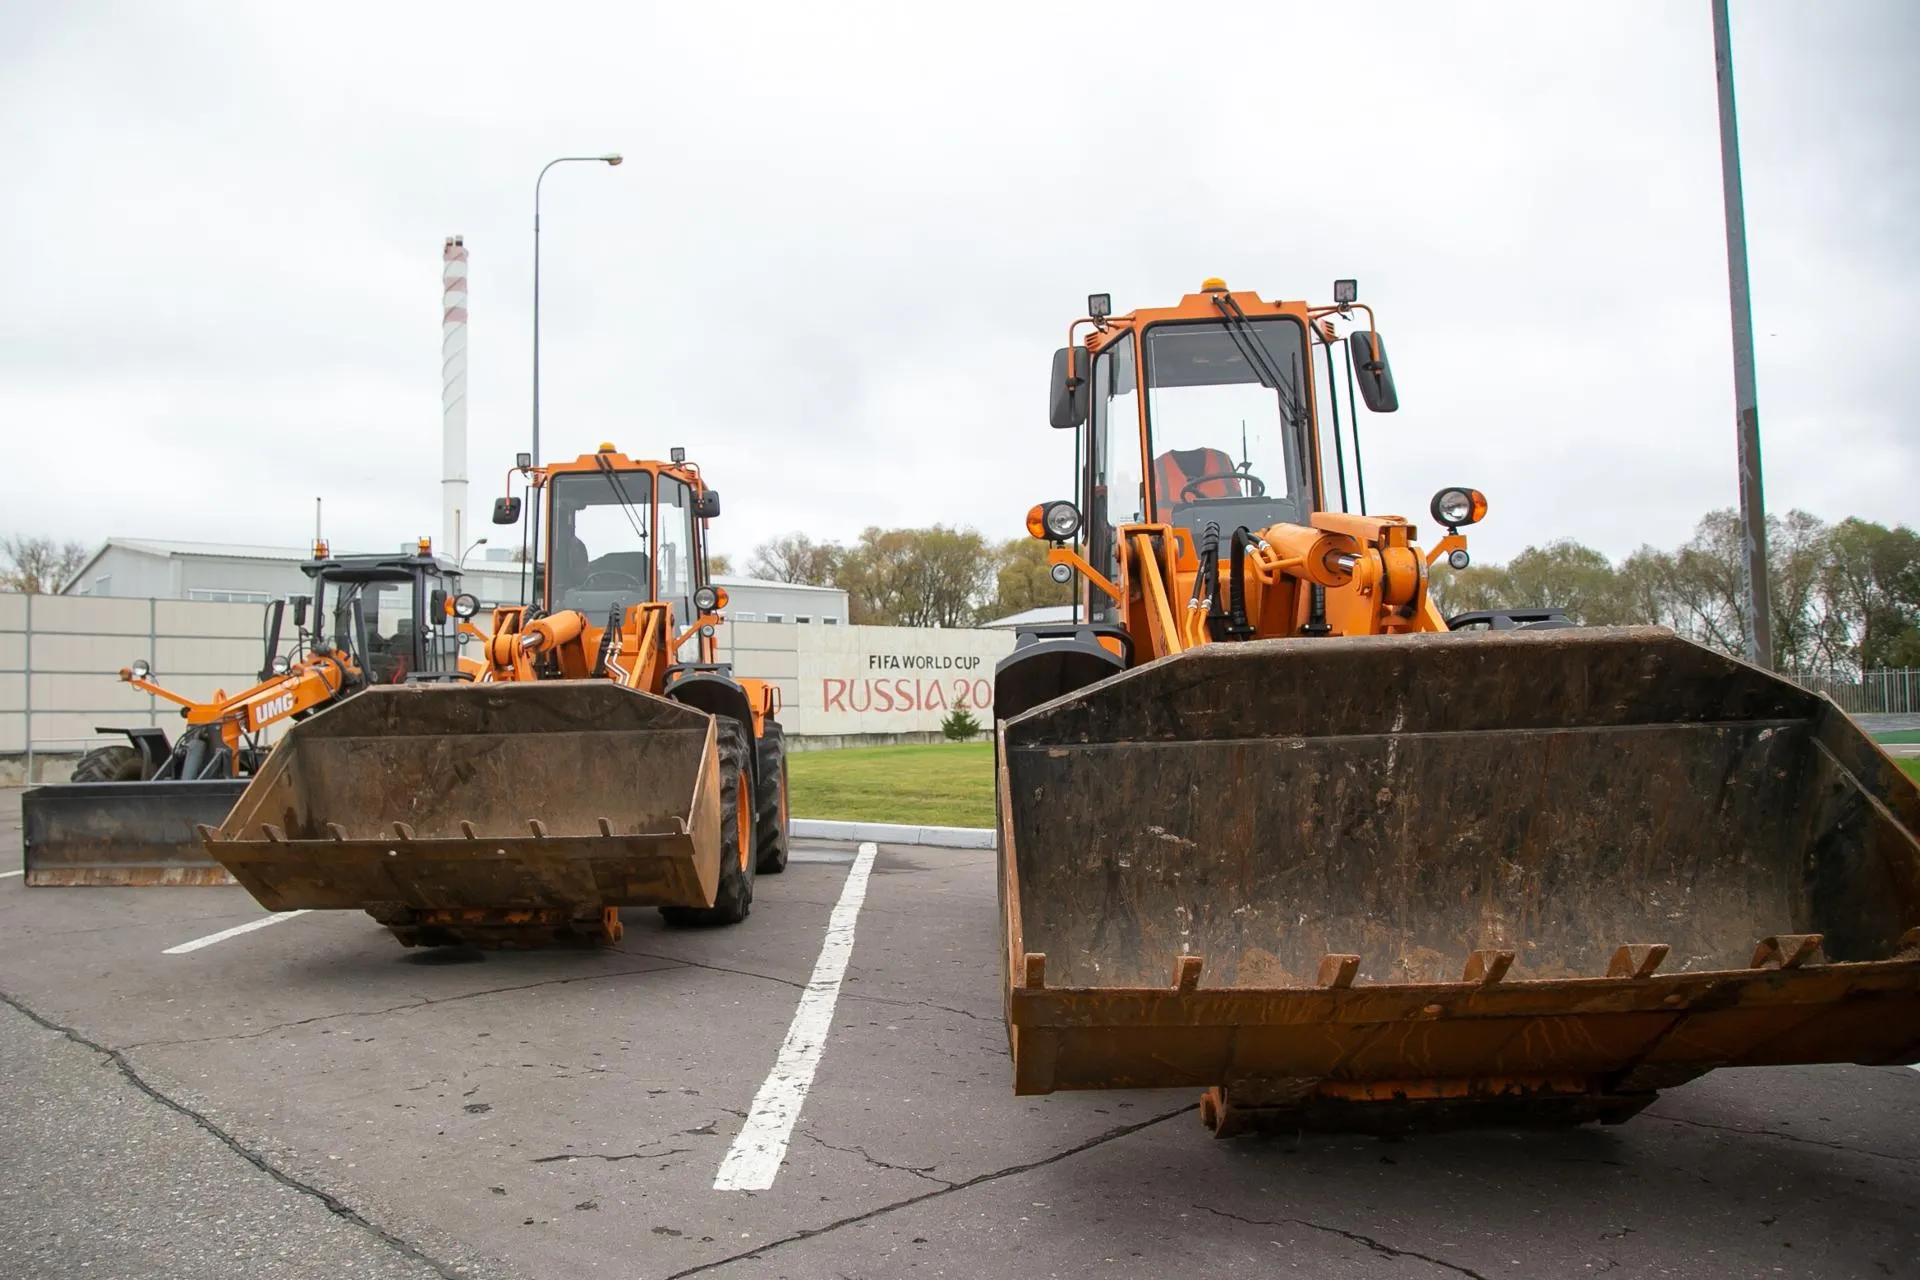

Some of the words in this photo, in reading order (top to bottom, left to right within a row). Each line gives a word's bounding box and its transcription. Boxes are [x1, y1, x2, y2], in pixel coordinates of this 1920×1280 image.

[869, 655, 900, 670] FIFA
[902, 656, 952, 670] WORLD
[954, 656, 981, 670] CUP
[255, 692, 294, 724] UMG
[823, 678, 948, 713] RUSSIA
